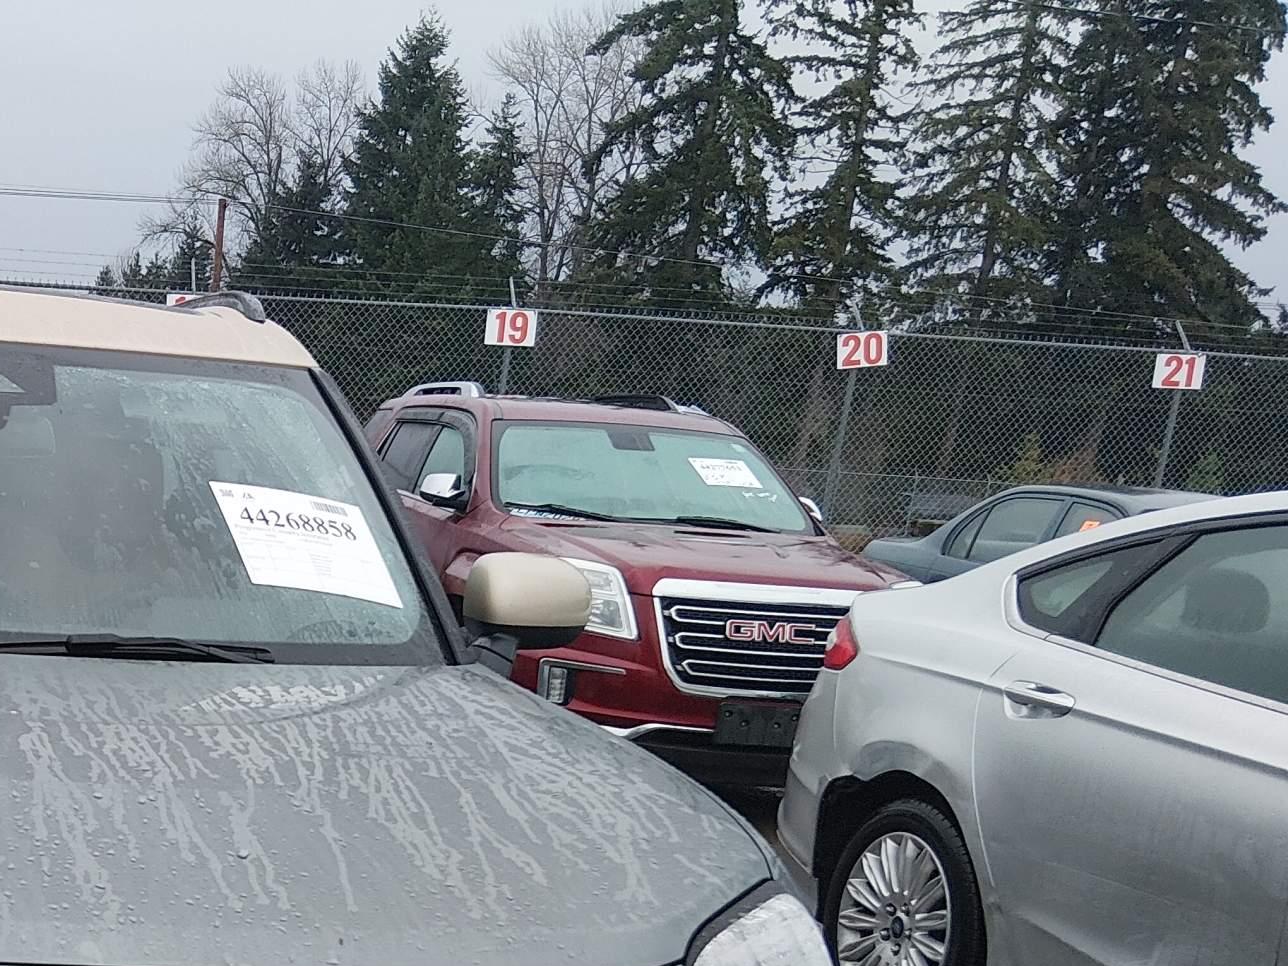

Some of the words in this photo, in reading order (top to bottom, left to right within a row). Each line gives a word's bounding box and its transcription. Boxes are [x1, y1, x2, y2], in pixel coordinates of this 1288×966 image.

[496, 311, 529, 344] 19
[842, 333, 882, 367] 20
[1161, 355, 1196, 387] 21
[239, 506, 358, 541] 44268858
[726, 620, 815, 644] GMC
